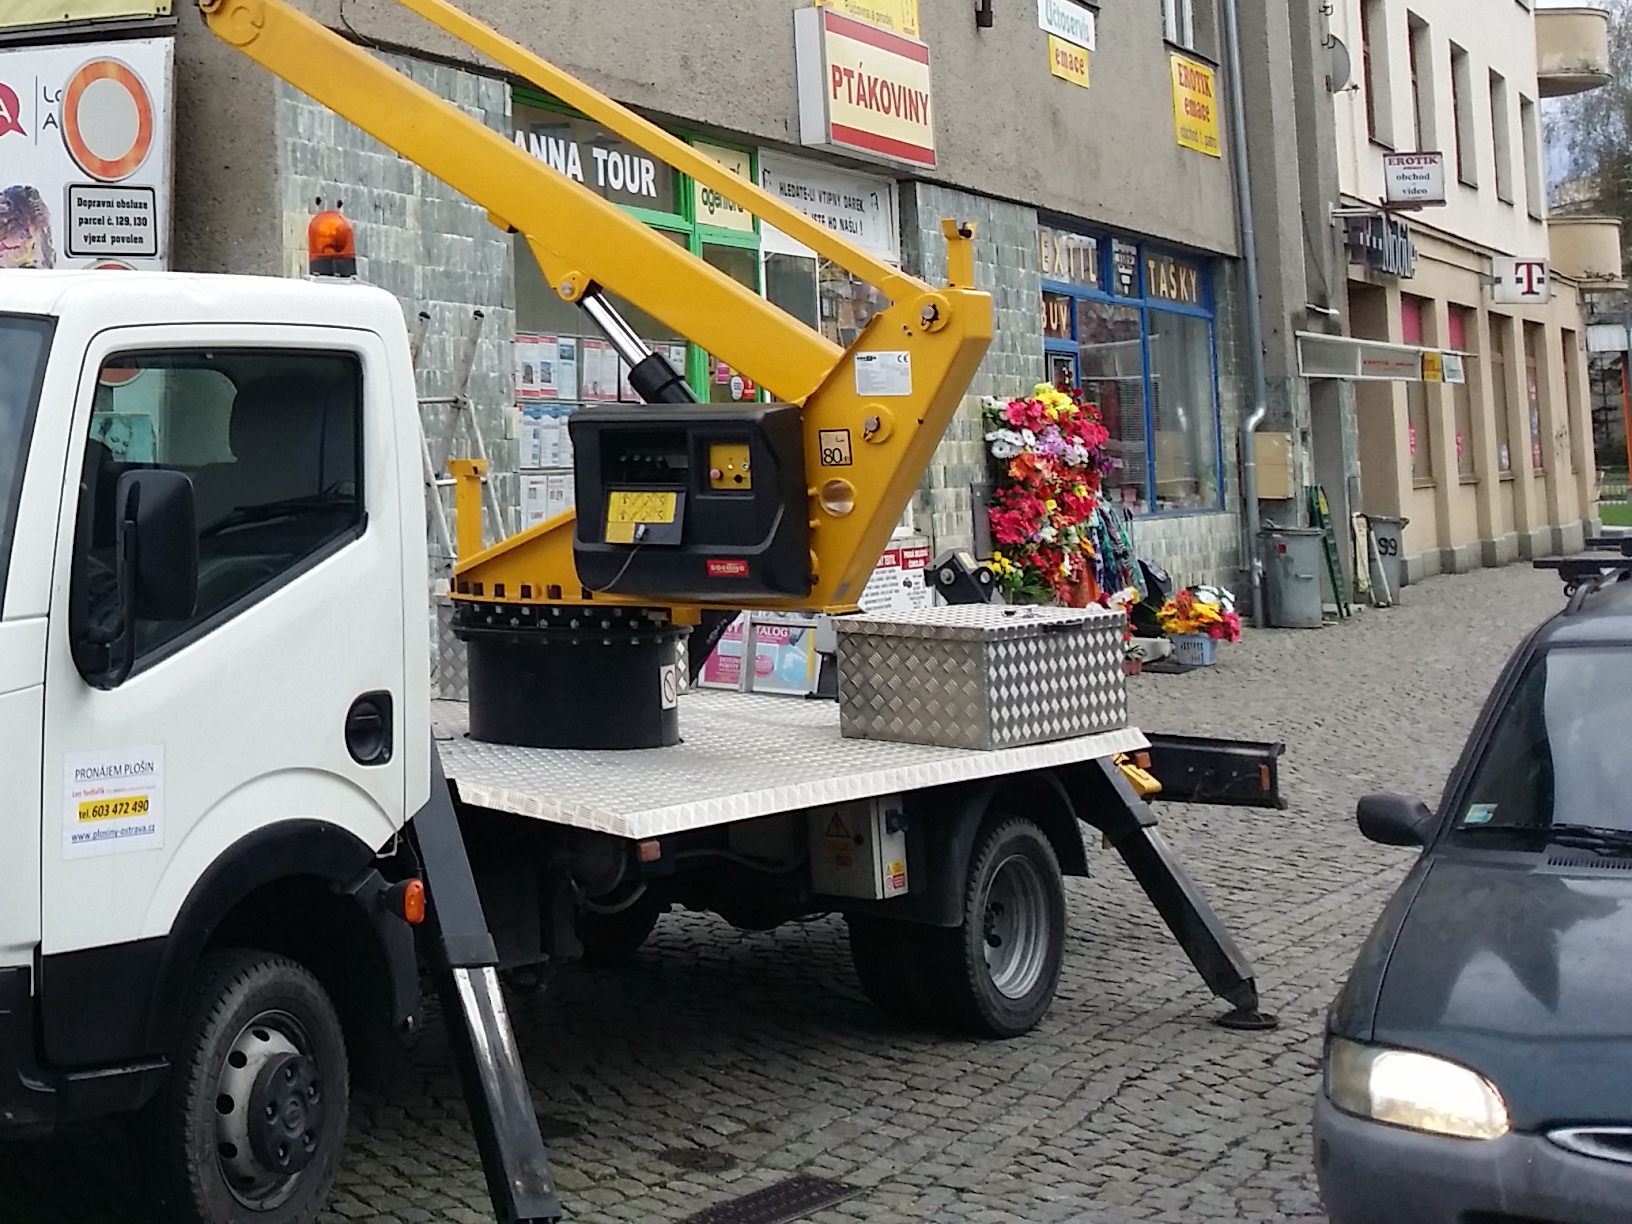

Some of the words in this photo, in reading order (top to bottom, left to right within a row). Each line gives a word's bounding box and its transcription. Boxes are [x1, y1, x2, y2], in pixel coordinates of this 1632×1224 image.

[1054, 47, 1085, 76] emace
[1177, 62, 1212, 99] EROTIK
[831, 62, 929, 127] PTÁKOVINY
[1183, 96, 1210, 123] emace
[1387, 156, 1438, 167] EROTIK
[592, 146, 658, 198] TOUR
[1396, 173, 1430, 181] obchod
[1402, 187, 1428, 195] video
[78, 215, 106, 227] parcel
[133, 216, 148, 226] 130
[828, 215, 837, 230] HO
[83, 232, 107, 245] vjezd
[110, 234, 144, 245] povolen
[1147, 255, 1197, 303] TAŠKY
[822, 447, 843, 464] 80
[74, 764, 122, 780] PRONÁJEM
[124, 760, 154, 775] PLOŠIN
[78, 809, 91, 819] tel.
[91, 804, 110, 818] 603
[111, 802, 130, 815] 472
[131, 799, 149, 813] 490
